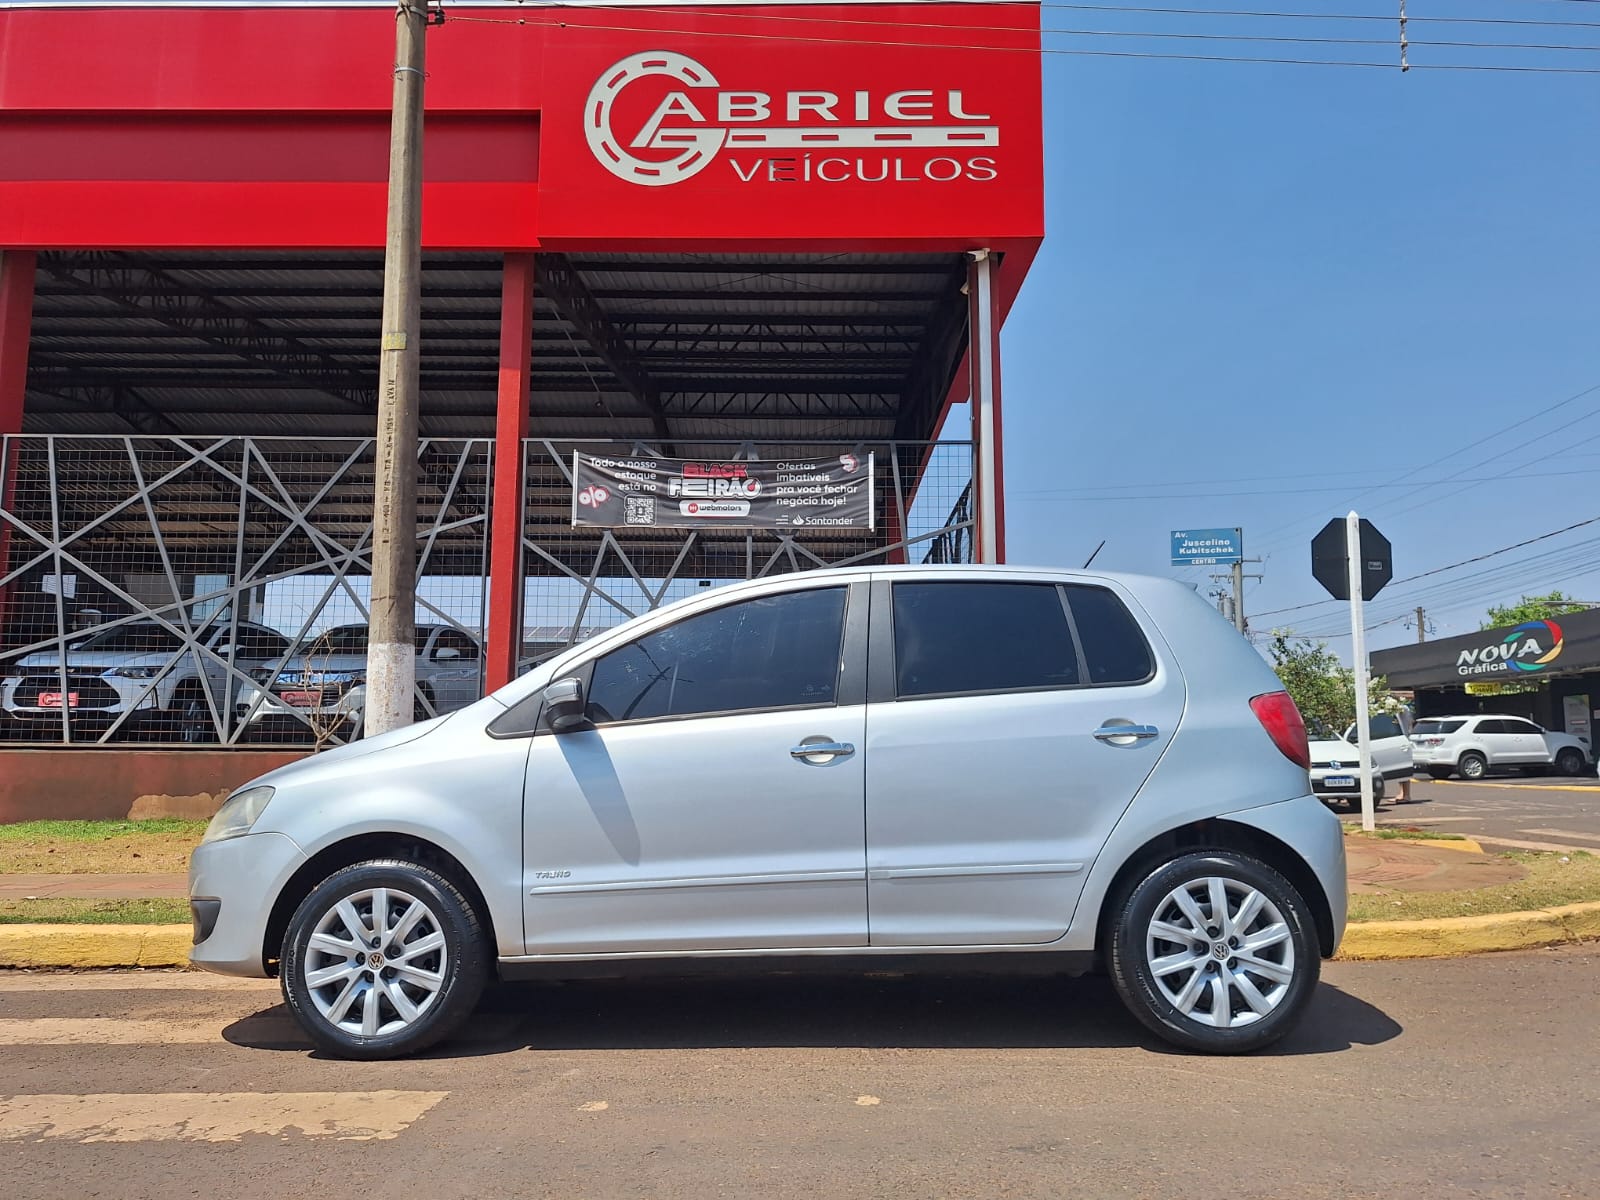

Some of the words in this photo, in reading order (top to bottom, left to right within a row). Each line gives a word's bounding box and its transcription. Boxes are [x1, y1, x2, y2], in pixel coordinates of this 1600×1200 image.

[729, 153, 998, 182] VEÍCULOS
[590, 457, 616, 468] Todo
[617, 461, 625, 469] o
[627, 460, 657, 469] nosso
[776, 462, 816, 471] Ofertas
[682, 463, 747, 478] BLACK
[618, 483, 641, 492] está
[643, 484, 657, 492] no
[668, 477, 761, 499] FEIRÃO
[776, 486, 795, 496] pra
[797, 485, 822, 494] você
[824, 484, 858, 494] fechar
[776, 496, 820, 507] negócio
[821, 496, 846, 507] hoje!
[699, 504, 742, 512] webmotors
[805, 516, 854, 526] Santander
[1179, 546, 1234, 554] Kubitschek
[1456, 638, 1543, 667] NOVA
[1458, 662, 1508, 676] Gráfica
